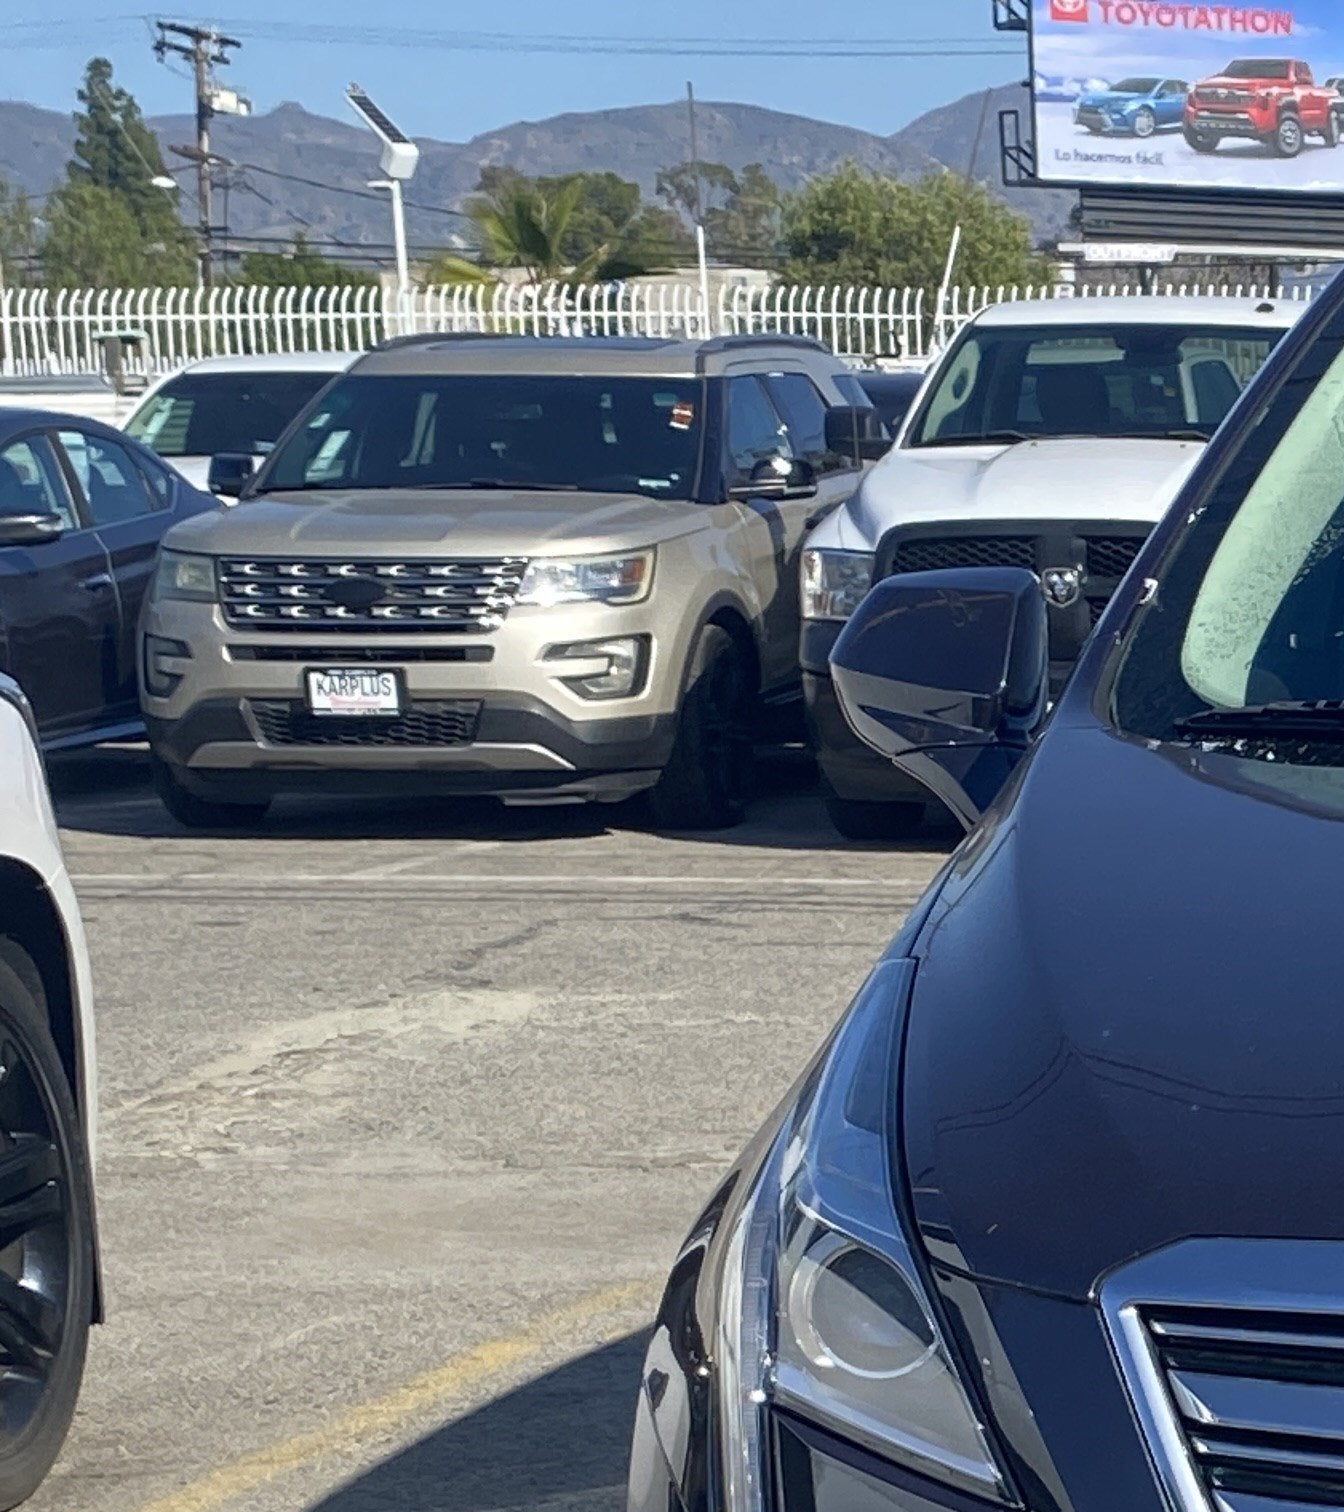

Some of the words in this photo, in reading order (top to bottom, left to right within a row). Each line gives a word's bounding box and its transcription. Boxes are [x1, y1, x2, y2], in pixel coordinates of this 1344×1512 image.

[1099, 1, 1293, 35] TOYOTATHON
[1054, 149, 1071, 161] Lo
[1073, 148, 1132, 164] hacemos
[316, 676, 392, 697] KARPLUS
